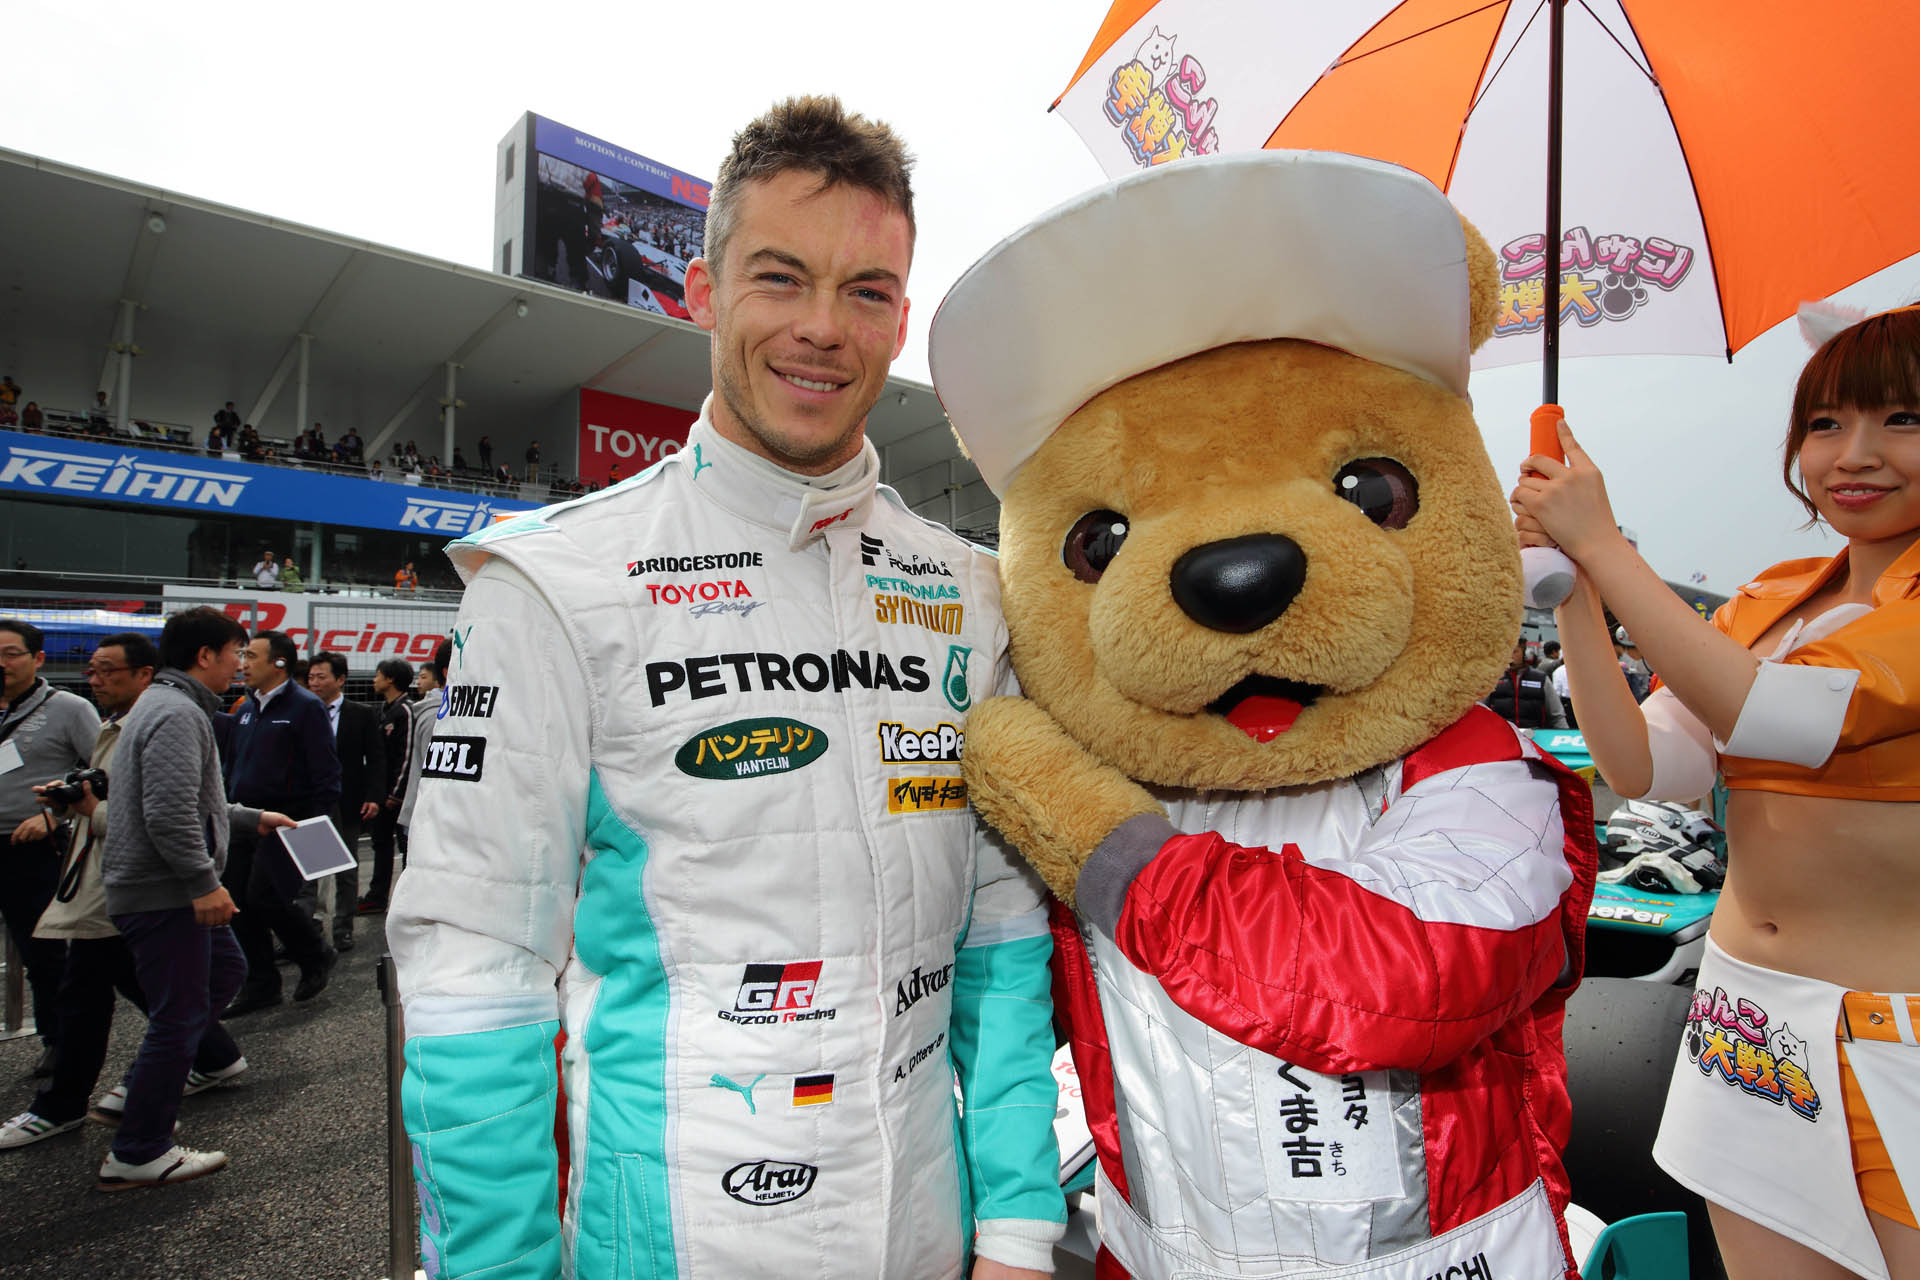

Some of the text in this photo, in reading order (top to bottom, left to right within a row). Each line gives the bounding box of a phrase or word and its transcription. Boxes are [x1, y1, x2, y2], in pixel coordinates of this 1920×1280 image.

[575, 136, 670, 179] MOTION & CONTROL
[0, 449, 252, 507] KEIHIN
[627, 552, 763, 577] BRIDGESTONE
[889, 557, 954, 577] FORMULA
[646, 580, 752, 605] TOYOTA
[865, 574, 961, 600] PETRONAS
[689, 600, 767, 619] Racing
[874, 594, 963, 635] SYNTIUM
[222, 602, 446, 662] Racing
[646, 649, 930, 707] PETRONAS
[449, 685, 499, 718] ENKEI
[695, 725, 816, 765] バンテリン
[735, 756, 790, 776] VANTELIN
[737, 980, 815, 1010] GR
[717, 1007, 836, 1025] GAZOO Racing
[1699, 1028, 1820, 1121] 大戦争
[1277, 1061, 1325, 1178] くま吉
[1329, 1140, 1347, 1176] きち
[731, 1164, 809, 1192] Arai
[1426, 1252, 1493, 1280] CHI
